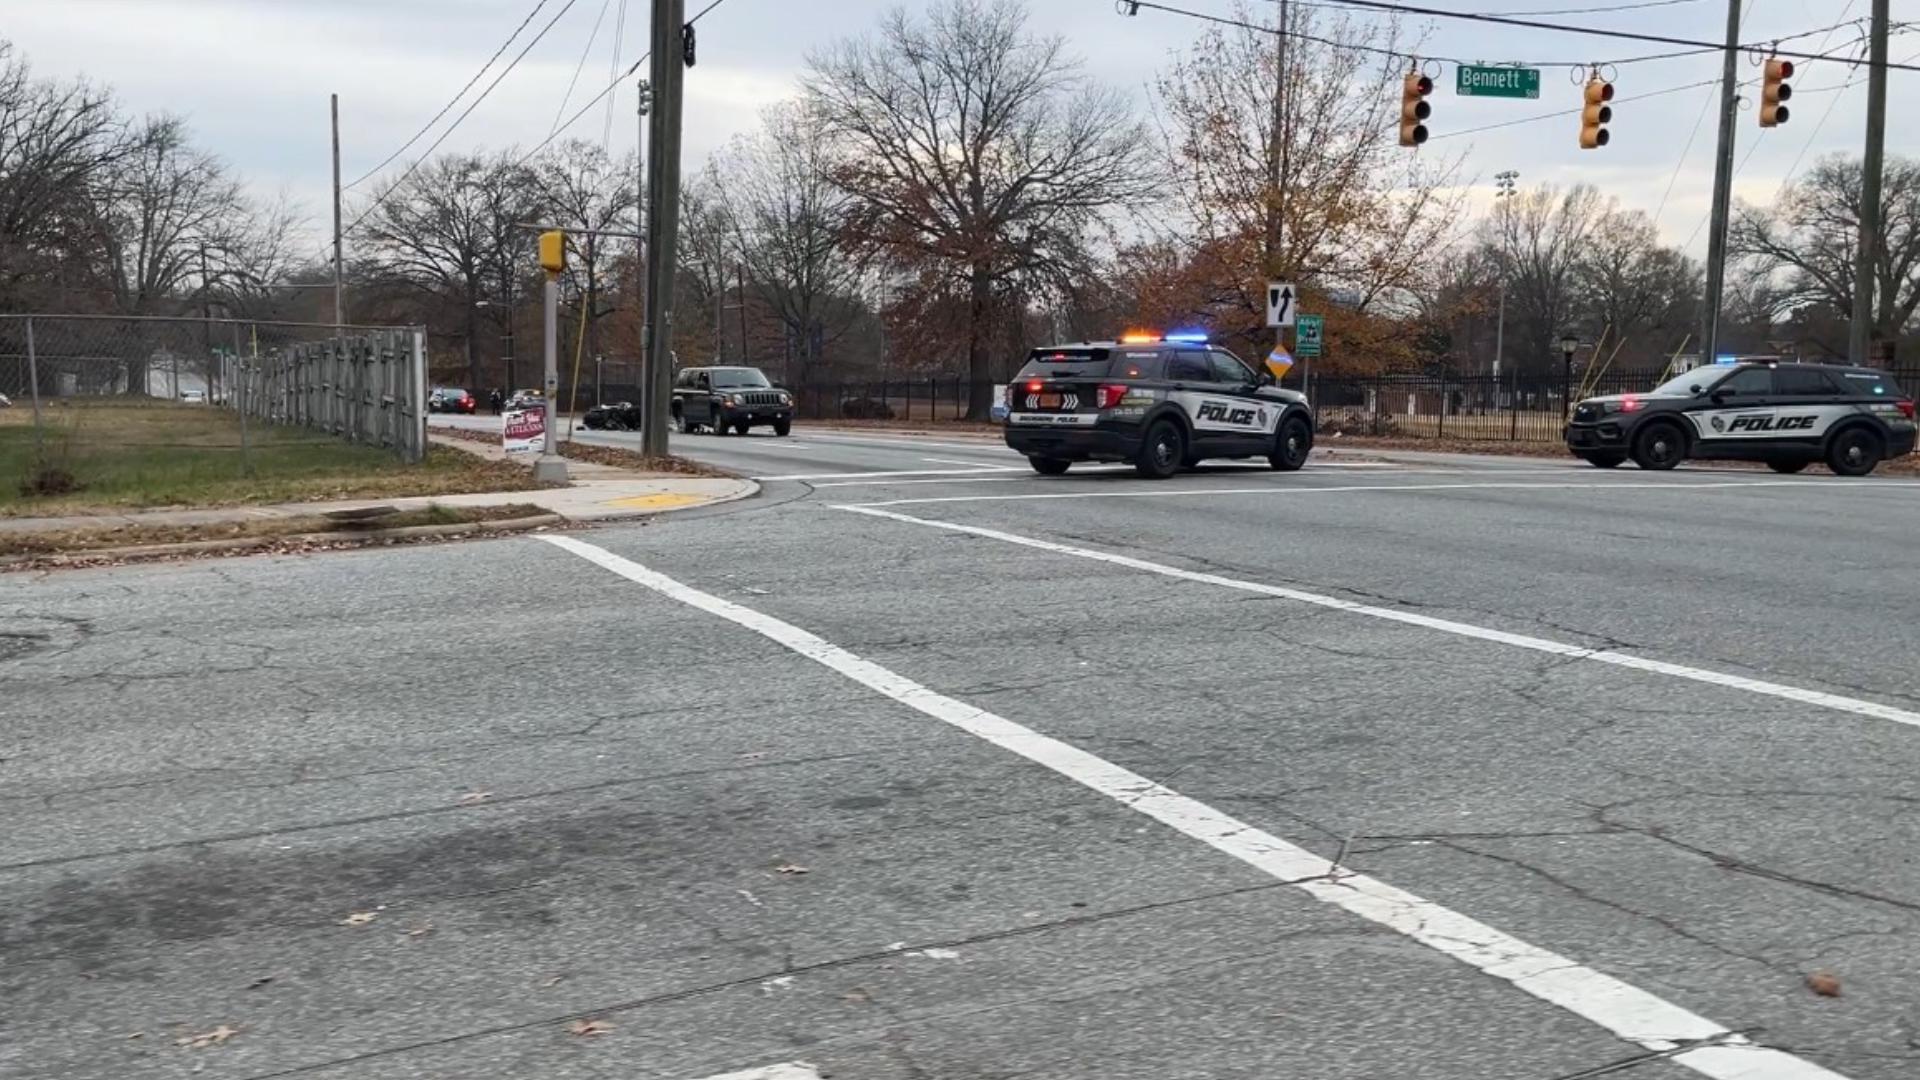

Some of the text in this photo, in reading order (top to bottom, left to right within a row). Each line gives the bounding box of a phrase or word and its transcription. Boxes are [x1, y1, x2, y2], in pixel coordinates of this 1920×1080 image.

[1462, 67, 1520, 88] Bennett
[1196, 405, 1256, 425] POLICE
[1727, 415, 1819, 432] POLICE
